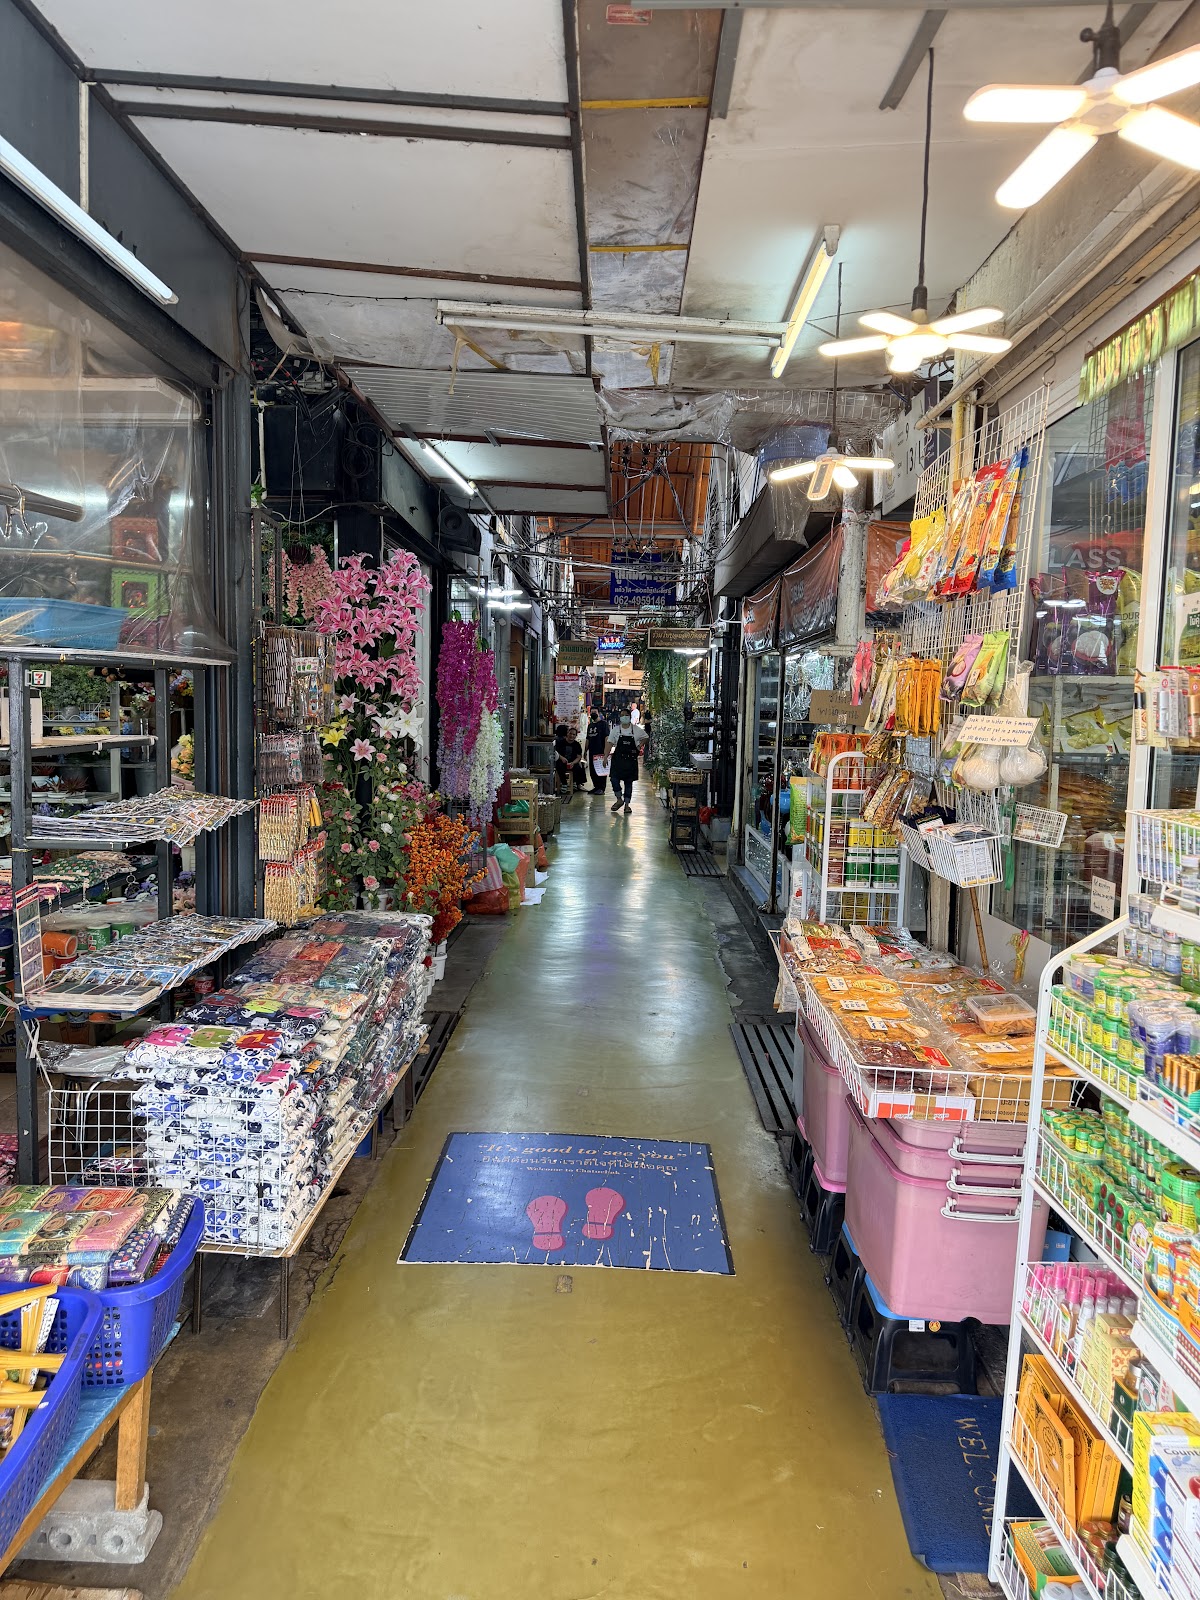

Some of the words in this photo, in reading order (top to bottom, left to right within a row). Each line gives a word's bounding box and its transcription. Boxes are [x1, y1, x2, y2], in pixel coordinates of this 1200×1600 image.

[613, 595, 666, 605] 062-4959146
[521, 1146, 573, 1155] good
[577, 1147, 597, 1155] to
